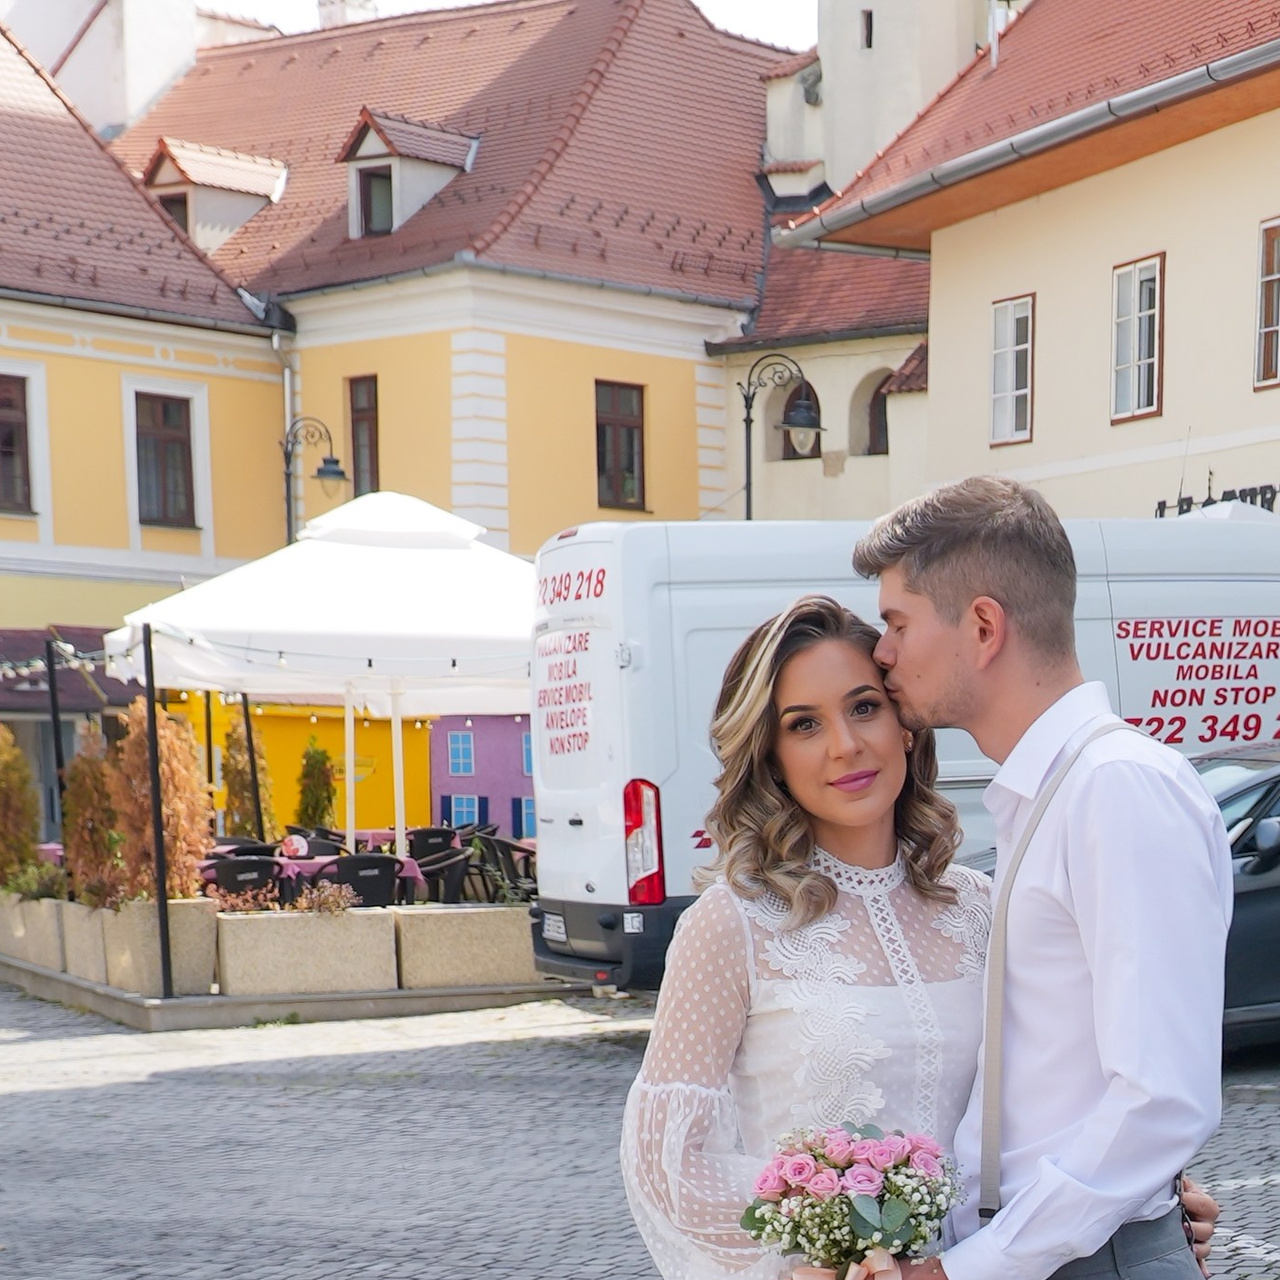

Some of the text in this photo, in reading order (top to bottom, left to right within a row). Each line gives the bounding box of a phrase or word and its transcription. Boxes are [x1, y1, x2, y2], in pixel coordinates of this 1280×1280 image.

[549, 571, 572, 605] 349
[574, 567, 606, 601] 218
[1116, 619, 1223, 639] SERVICE
[537, 632, 590, 658] VULCANIZARE
[547, 658, 577, 682] MOBILA
[1176, 664, 1259, 681] MOBILA
[565, 682, 592, 704] MOBIL
[1151, 686, 1277, 708] NON STOP
[545, 707, 587, 731] ANVELOPE
[1198, 713, 1262, 743] 349
[549, 731, 590, 756] NON STOP
